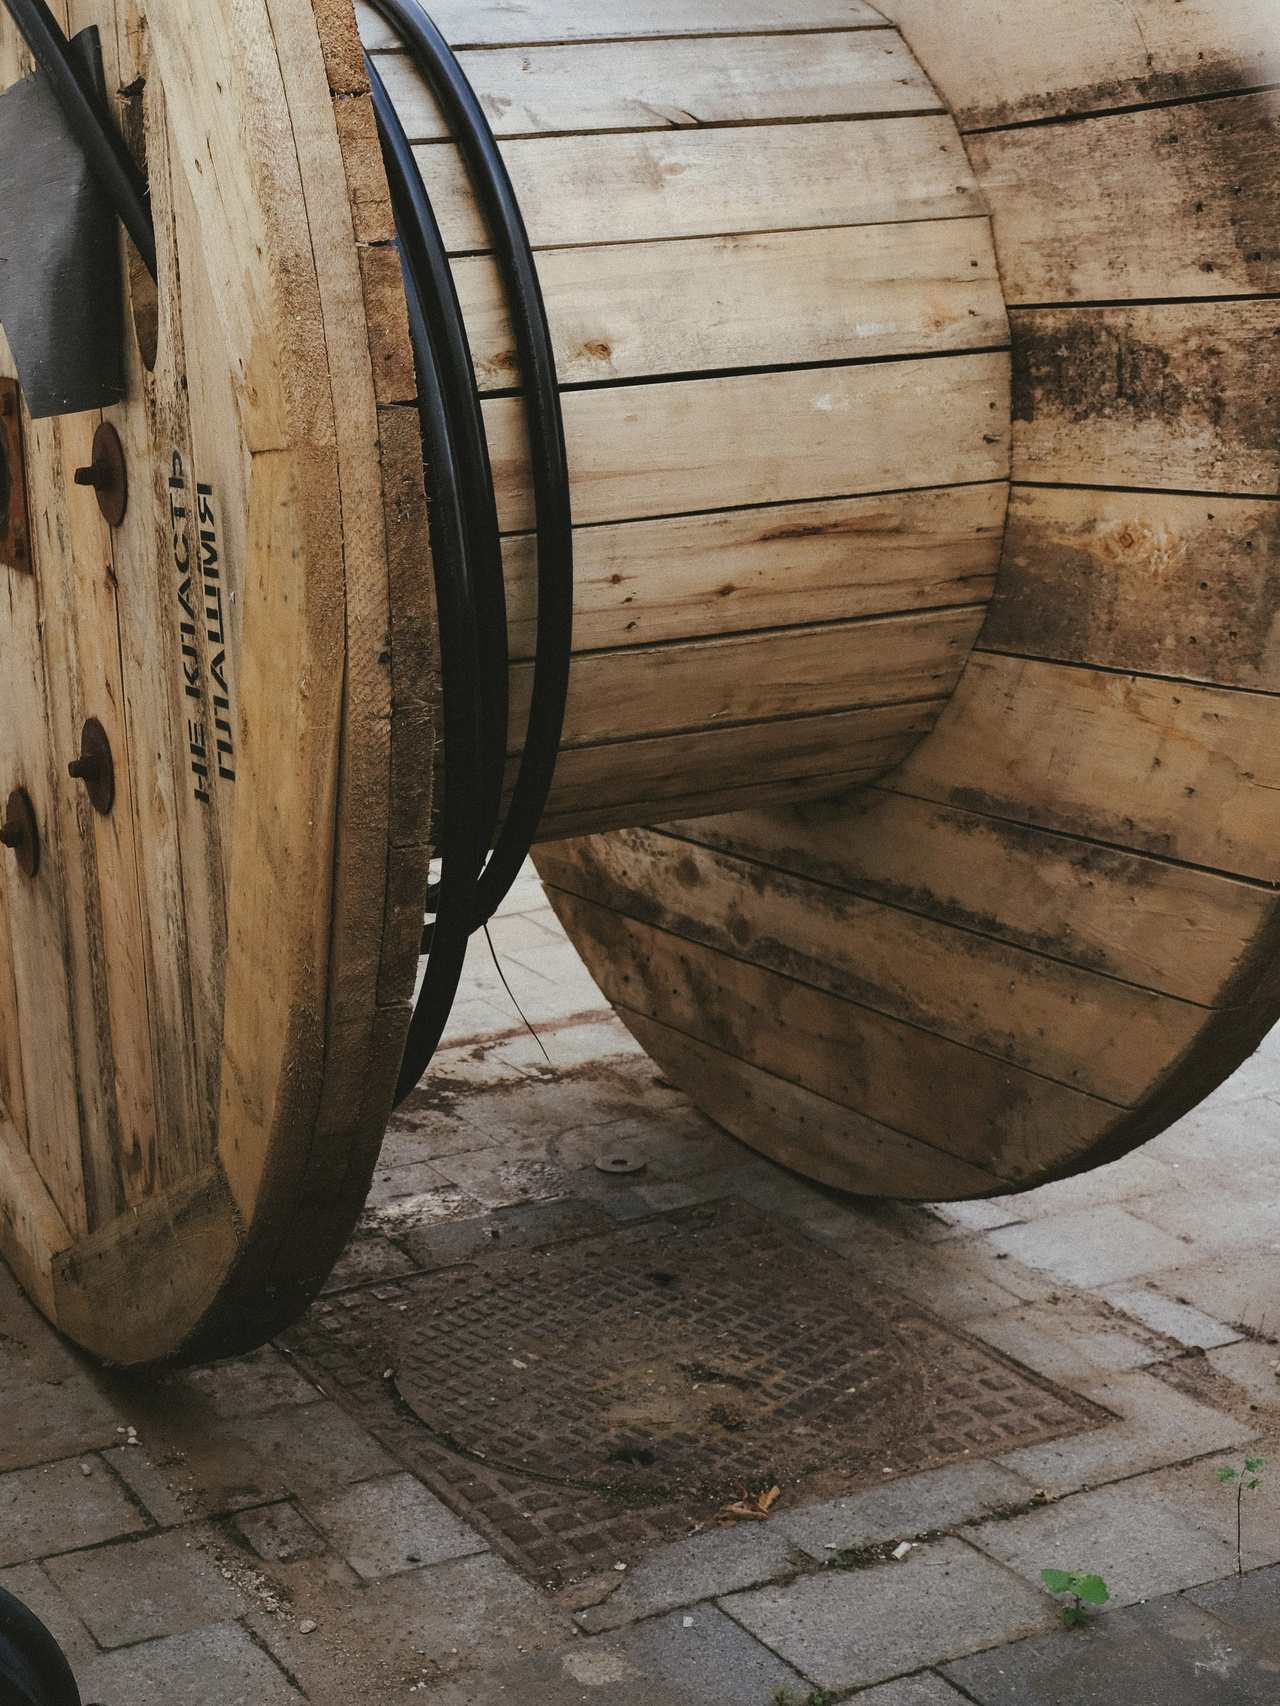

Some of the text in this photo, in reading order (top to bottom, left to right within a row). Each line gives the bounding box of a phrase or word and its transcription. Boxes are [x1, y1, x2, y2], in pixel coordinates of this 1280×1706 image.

[169, 450, 210, 803] НЕ КЛАСТЬ
[197, 482, 236, 783] ПЛАШМЯ
